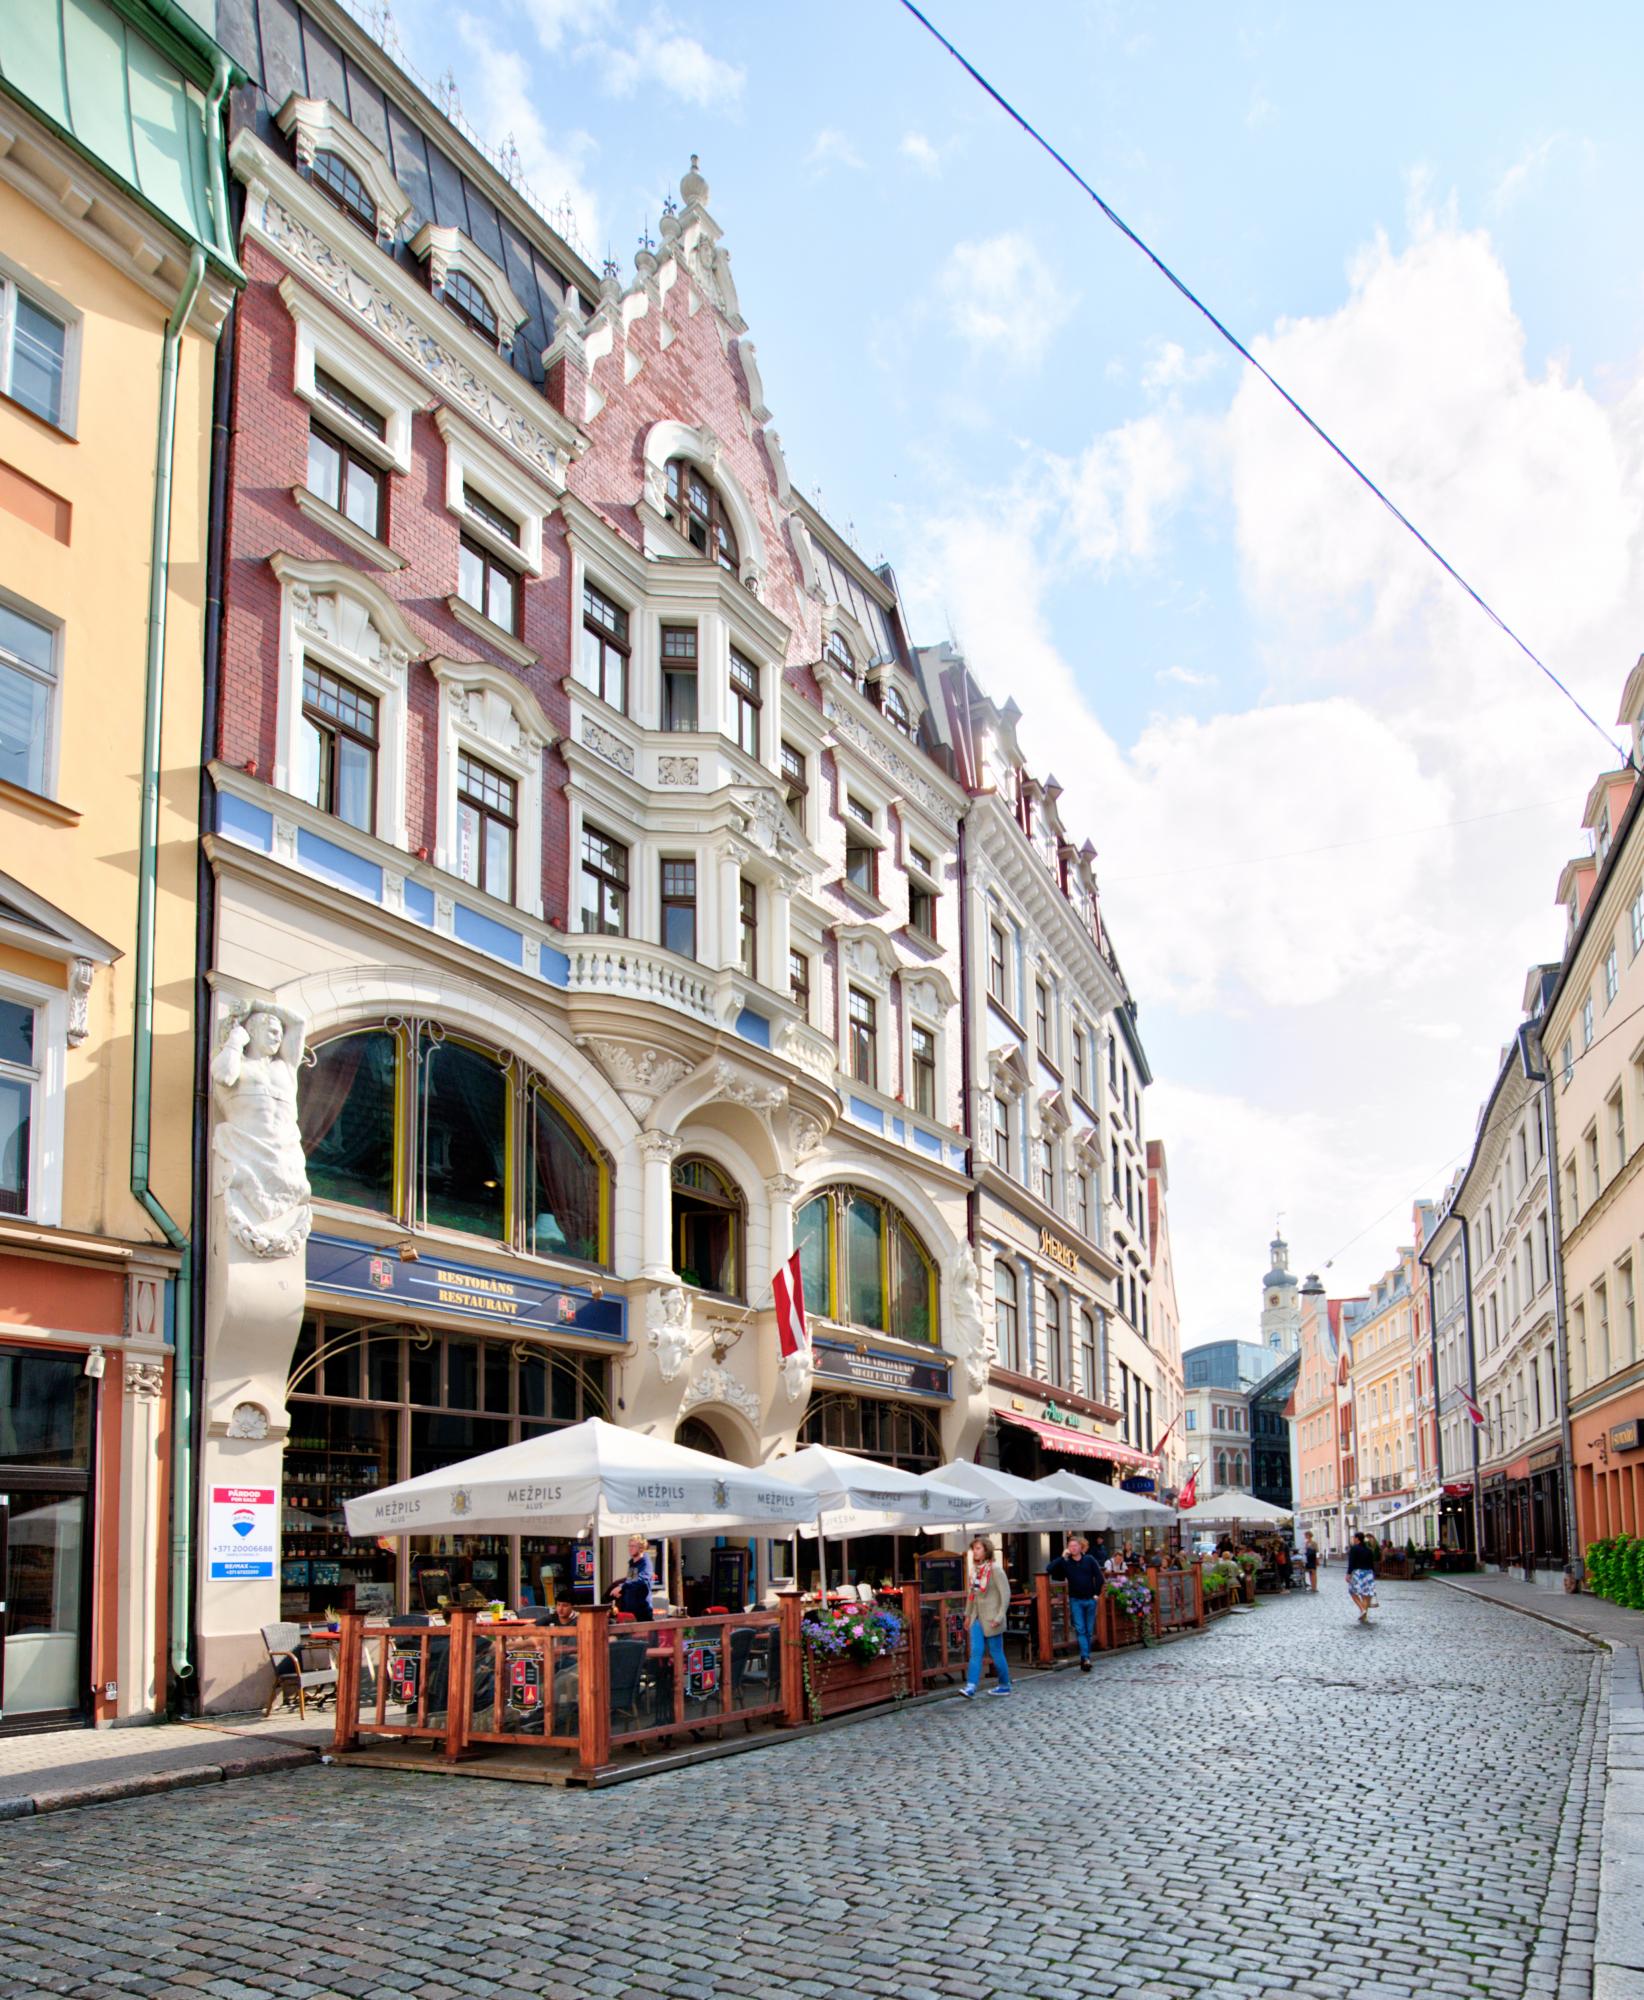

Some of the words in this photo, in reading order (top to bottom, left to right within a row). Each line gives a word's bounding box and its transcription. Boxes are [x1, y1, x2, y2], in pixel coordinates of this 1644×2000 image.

[437, 1269, 515, 1296] RESTORĀNS
[438, 1289, 518, 1315] RESTAURANT
[228, 1489, 261, 1498] PĀRDOD
[507, 1485, 562, 1503] MEŽPILS
[636, 1483, 685, 1499] MEŽPILS
[757, 1491, 796, 1507] MEŽPILS
[375, 1500, 421, 1519] MEŽPILS
[526, 1502, 544, 1510] ALUS
[390, 1515, 406, 1524] ALUS
[213, 1545, 231, 1553] +371
